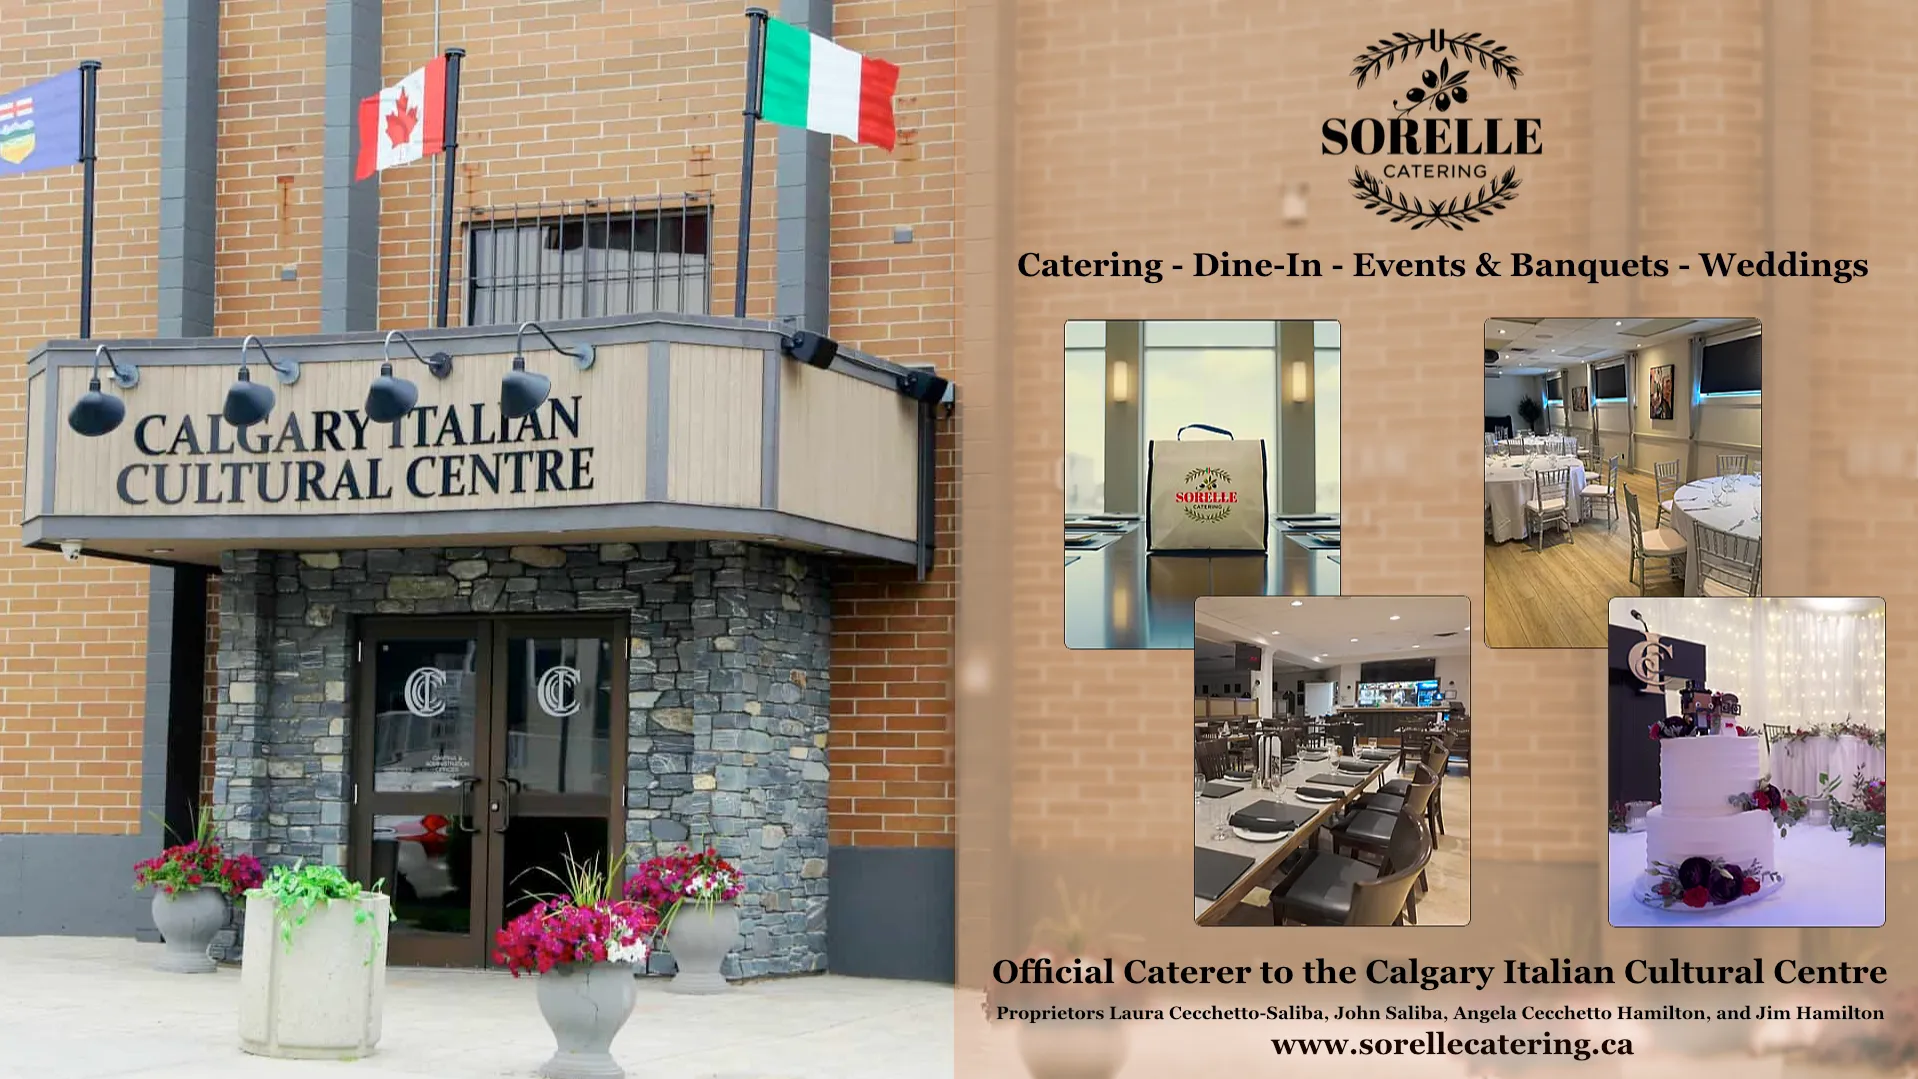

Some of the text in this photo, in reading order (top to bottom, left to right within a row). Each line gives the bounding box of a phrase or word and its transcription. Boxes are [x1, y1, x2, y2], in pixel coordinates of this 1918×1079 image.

[134, 408, 371, 456] CALGARY
[116, 447, 595, 504] CULTURAL CENTRE
[1175, 492, 1238, 503] SORELLE
